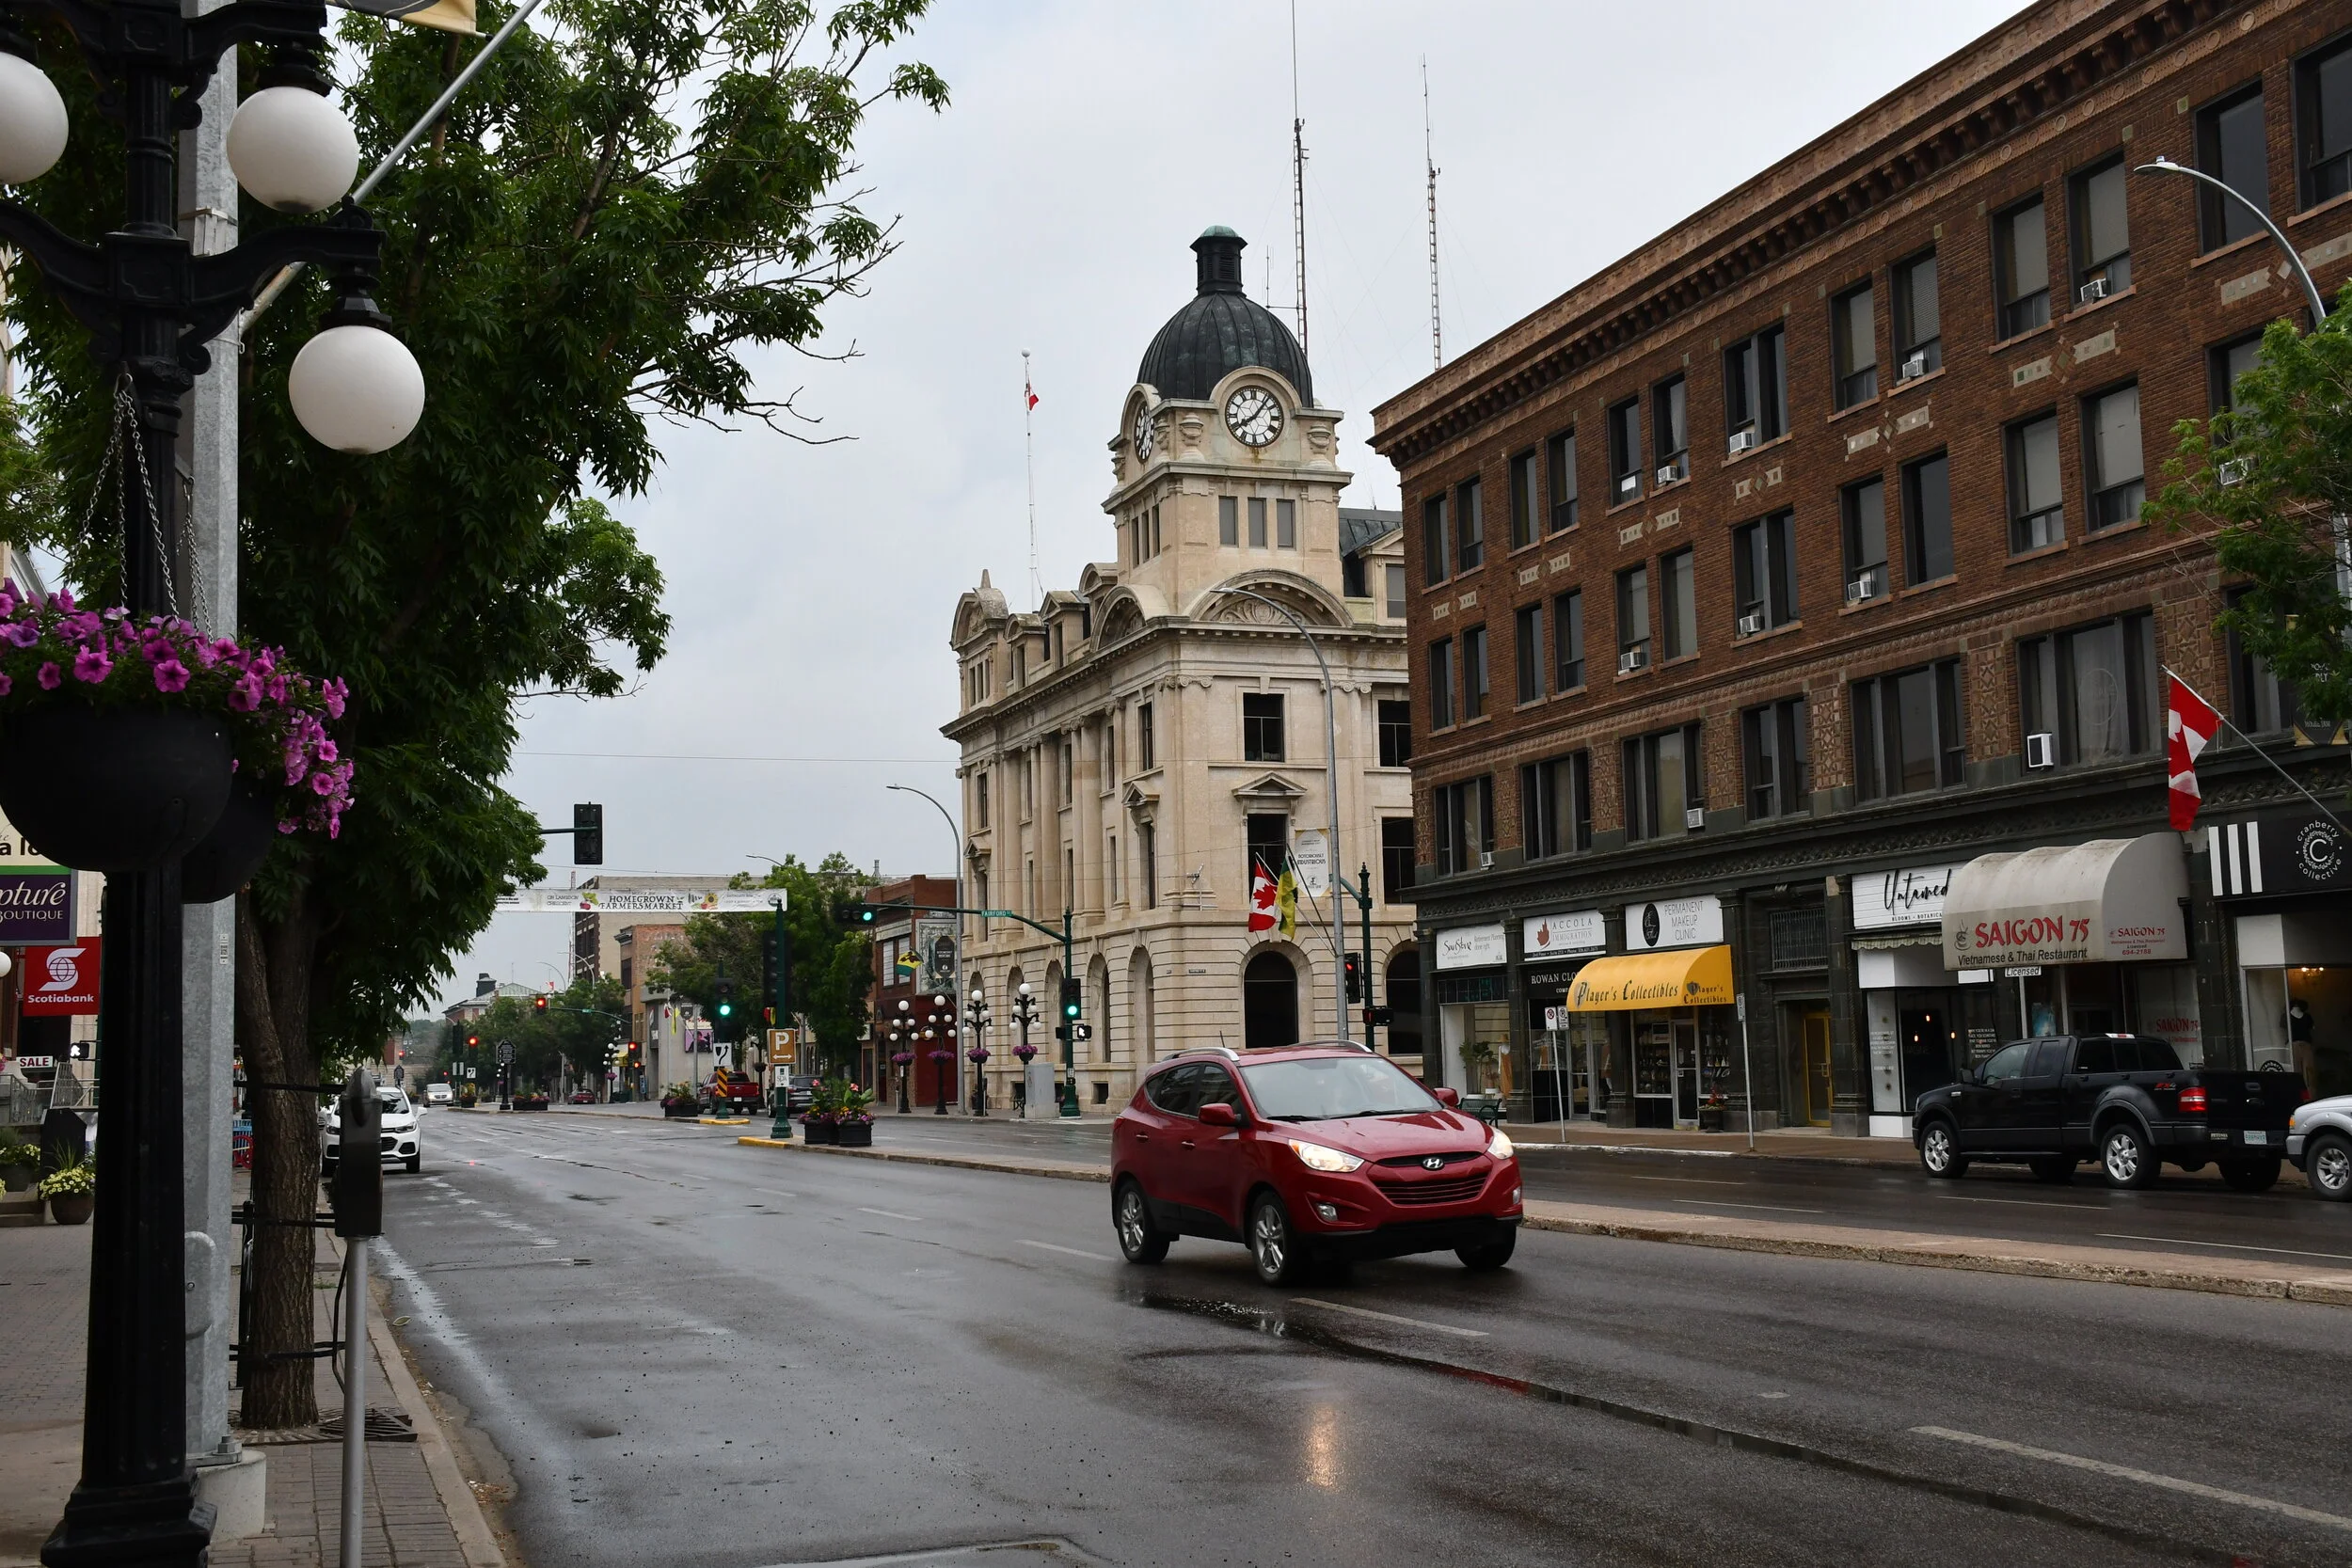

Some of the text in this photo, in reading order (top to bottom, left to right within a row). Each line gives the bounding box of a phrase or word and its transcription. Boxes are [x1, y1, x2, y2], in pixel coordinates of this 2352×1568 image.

[2297, 820, 2339, 842] cranberry
[2298, 859, 2341, 880] collective
[1884, 868, 1951, 915] Untamed
[1664, 900, 1703, 915] PERMANENT
[1552, 918, 1592, 929] ACCOLA
[1671, 914, 1697, 927] MAKEUP
[1552, 930, 1592, 942] IMMIGRATION
[1675, 928, 1696, 941] CLINIC
[1976, 915, 2090, 948] SAIGON 75
[2118, 927, 2155, 937] SAIGON
[1958, 947, 2088, 966] Vietnamese & Thai Restaurant
[2006, 966, 2040, 976] Licensed
[1531, 973, 1559, 985] ROWAN
[28, 994, 94, 1003] Scotiabank
[1577, 979, 1678, 1007] Player's Collectibles
[1683, 993, 1727, 1005] Collectibles
[2156, 1018, 2189, 1033] SAIGON
[775, 1032, 789, 1051] P
[20, 1057, 49, 1067] SALE
